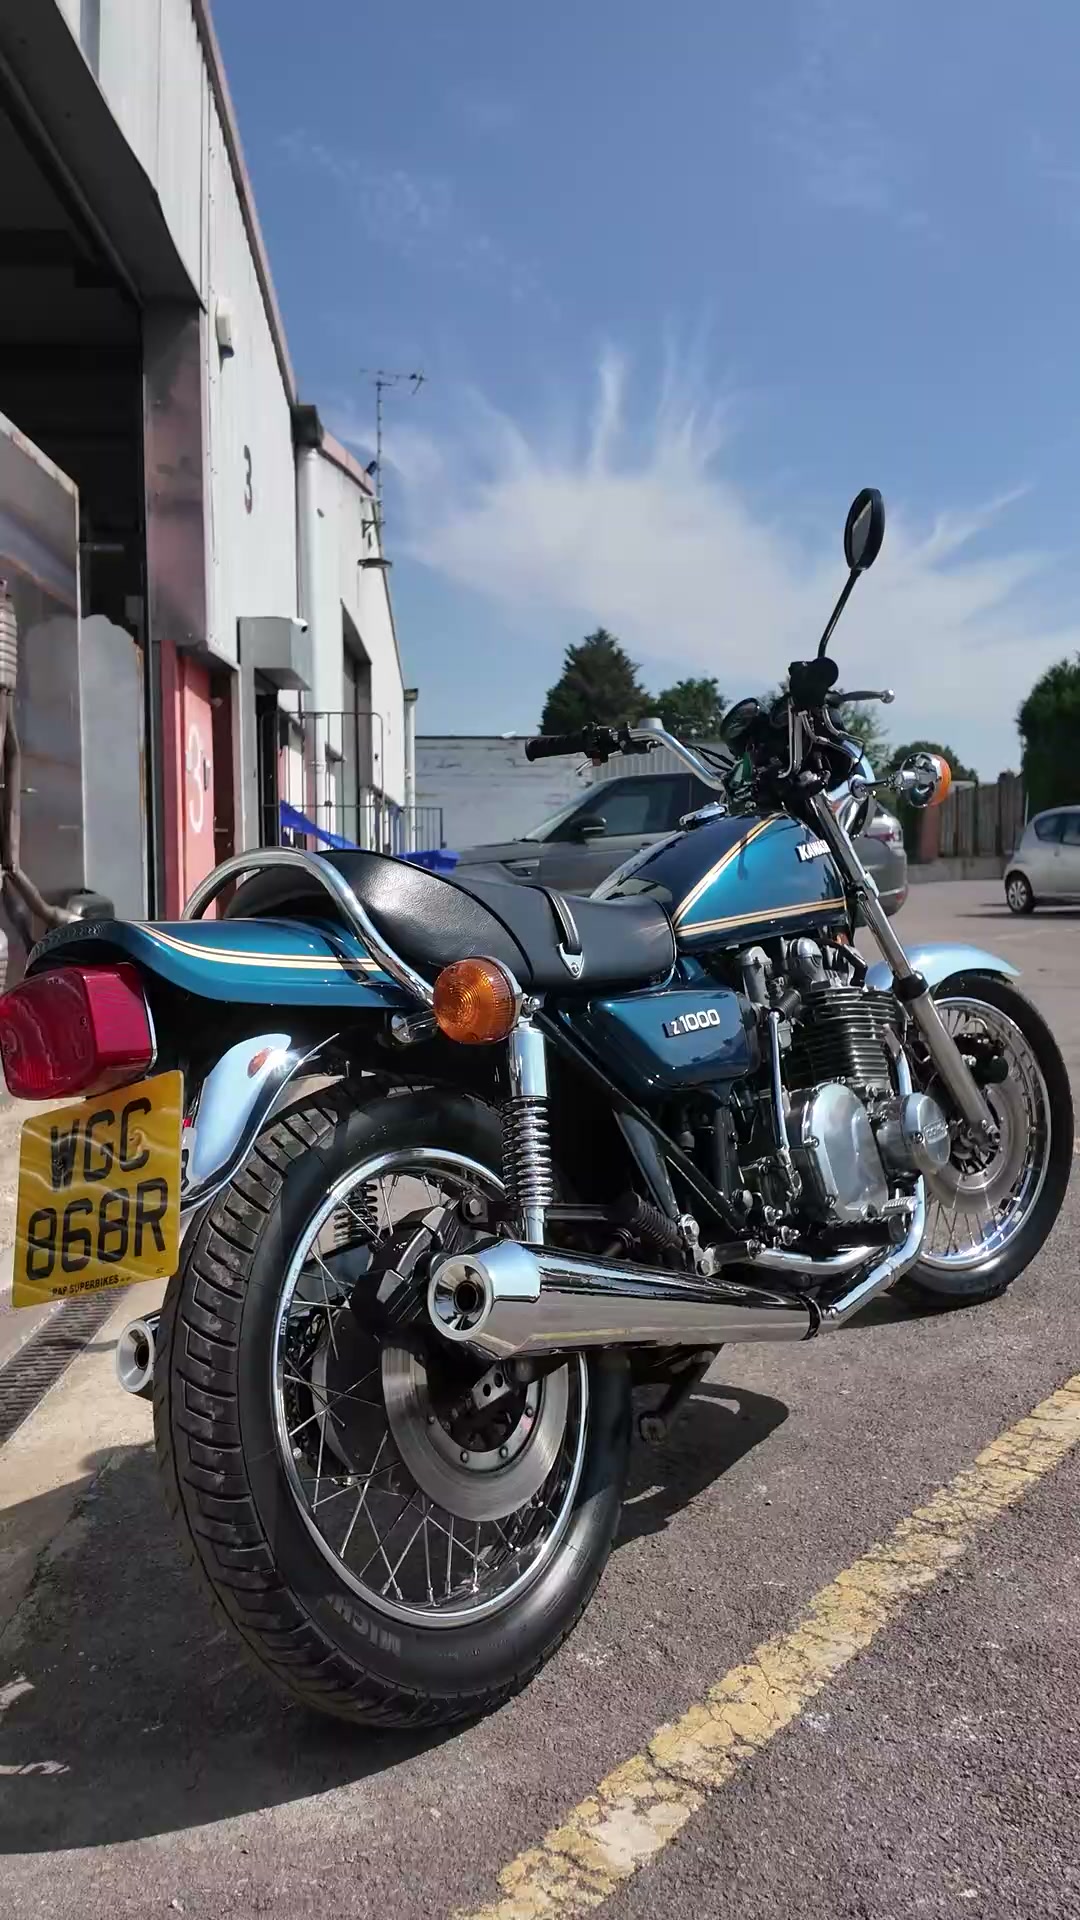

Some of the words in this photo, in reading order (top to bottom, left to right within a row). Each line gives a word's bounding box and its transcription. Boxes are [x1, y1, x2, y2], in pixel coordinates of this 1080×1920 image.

[244, 444, 253, 514] 3
[187, 723, 204, 832] 3
[50, 1097, 152, 1192] WGC
[26, 1177, 169, 1280] 868R
[69, 1275, 120, 1294] SUPERBIKES
